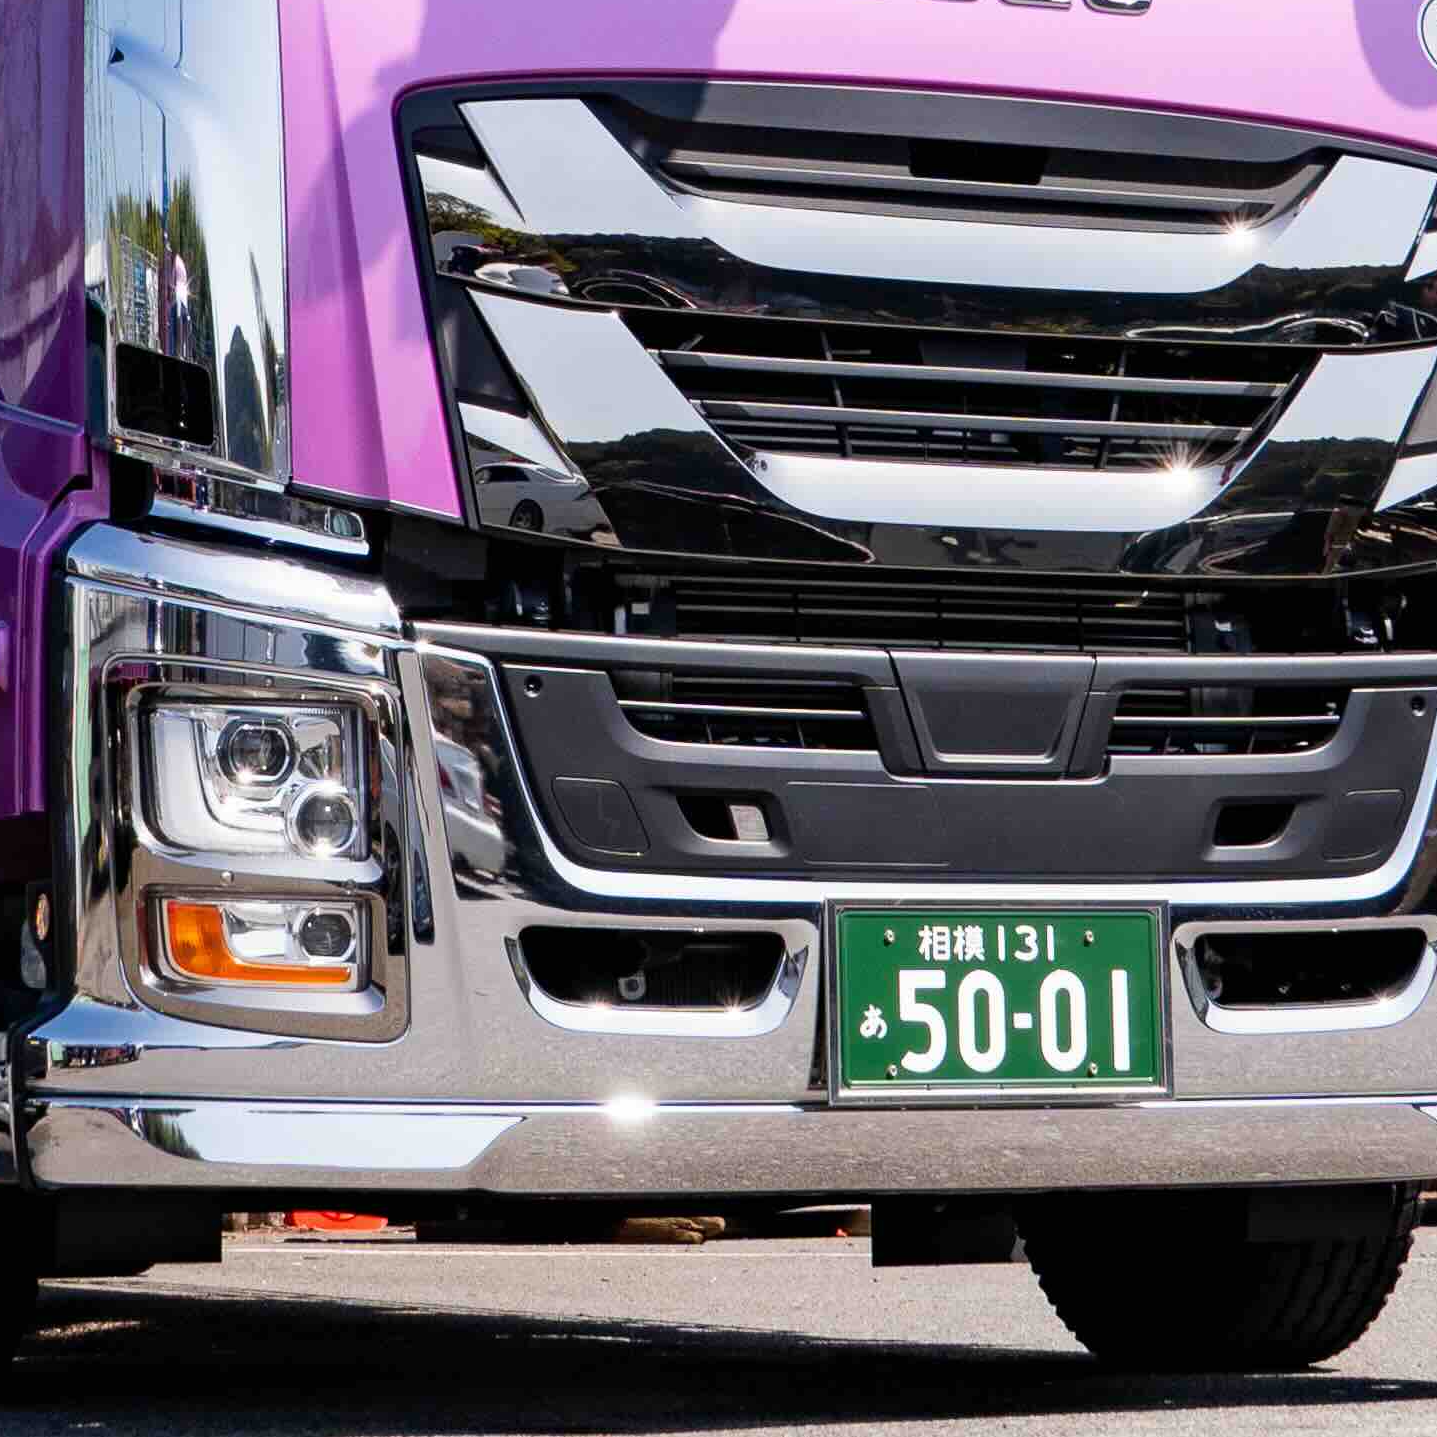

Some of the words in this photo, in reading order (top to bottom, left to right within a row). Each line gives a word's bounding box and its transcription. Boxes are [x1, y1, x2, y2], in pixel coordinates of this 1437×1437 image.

[918, 924, 986, 962] 相模
[997, 924, 1056, 963] 131
[859, 1004, 888, 1040] あ
[898, 968, 1131, 1074] 50-01
